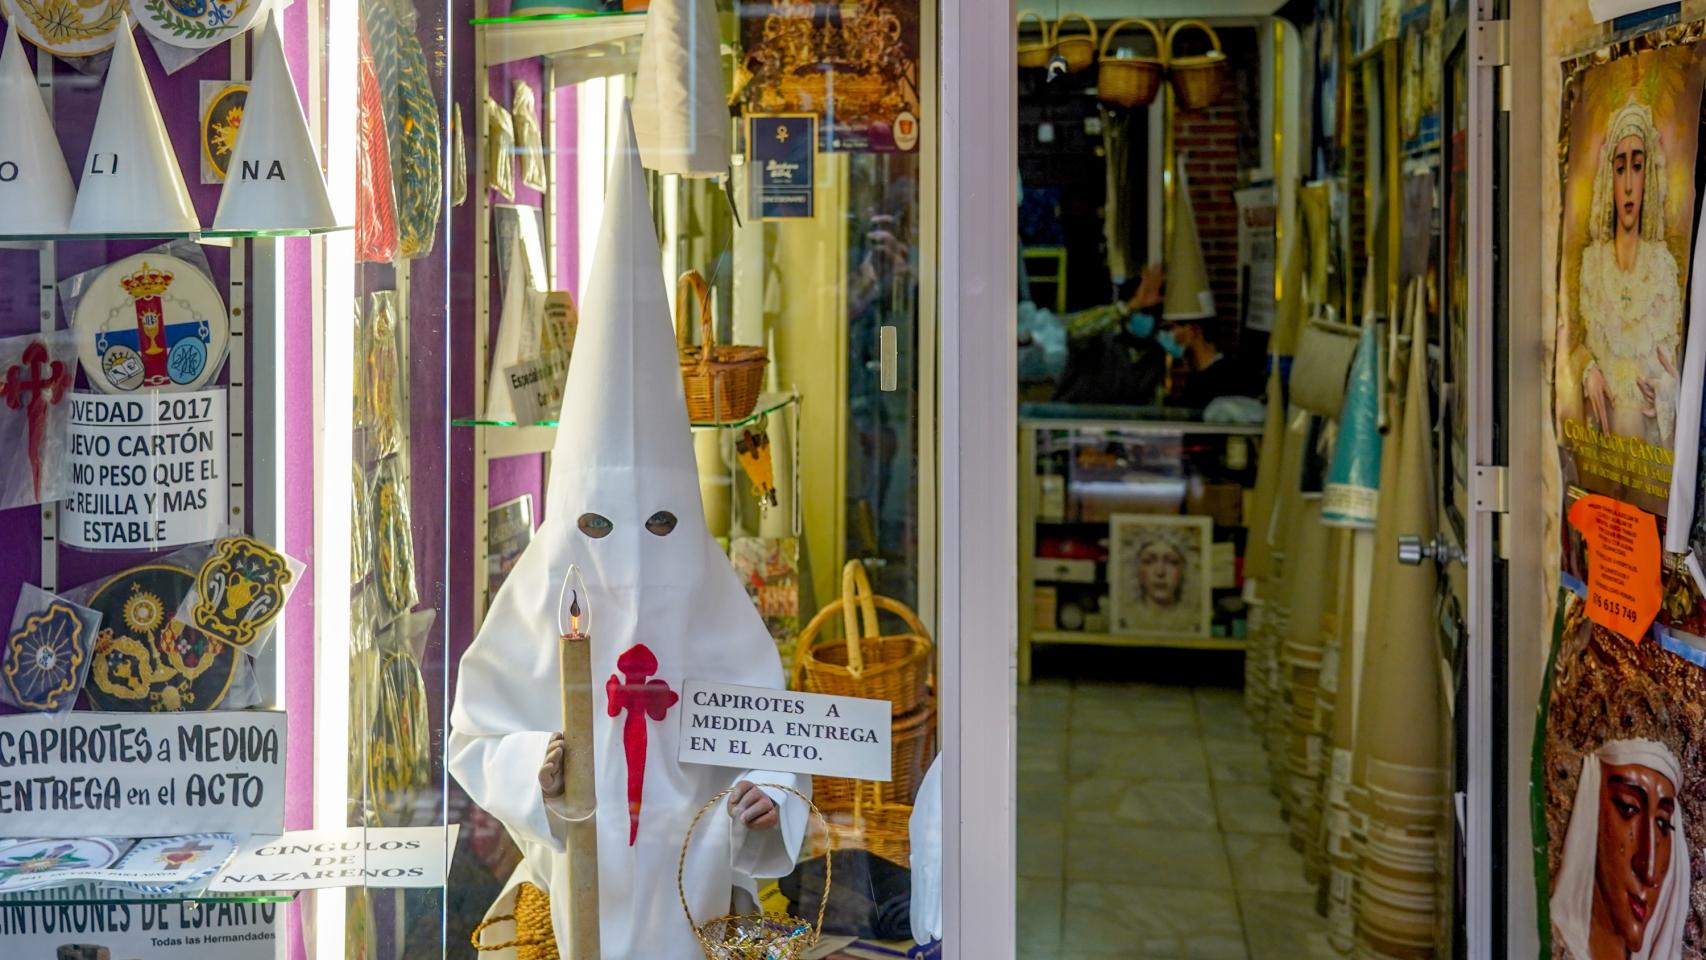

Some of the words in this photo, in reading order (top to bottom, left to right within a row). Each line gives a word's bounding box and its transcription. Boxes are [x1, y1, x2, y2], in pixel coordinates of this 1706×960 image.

[158, 397, 213, 422] 2017
[117, 427, 214, 457] CARTÓN
[99, 464, 147, 487] PESO
[153, 460, 195, 488] QUE
[200, 459, 219, 481] EL
[77, 493, 137, 515] REJILLA
[144, 492, 157, 514] Y
[163, 488, 208, 513] MAS
[83, 519, 167, 544] ESTABLE
[692, 690, 806, 715] CAPIROTES
[825, 703, 841, 718] A
[691, 713, 775, 735] MEDIDA
[785, 721, 879, 744] ENTREGA
[0, 723, 153, 767] CAPIROTES
[156, 737, 171, 763] a
[178, 724, 279, 765] MEDIDA
[690, 736, 717, 752] EN
[728, 739, 752, 755] EL
[762, 742, 823, 761] ACTO.
[0, 775, 122, 814] ENTREGA
[127, 785, 150, 806] en
[158, 777, 175, 806] el
[186, 772, 264, 808] ACTO
[254, 839, 421, 857] CINGULOS
[313, 855, 356, 866] DE
[222, 866, 424, 884] NAZARENOS
[0, 882, 131, 935] INTURONES
[142, 890, 169, 932] DE
[151, 936, 183, 948] Todas
[186, 935, 201, 945] las
[204, 931, 276, 945] Hermandades
